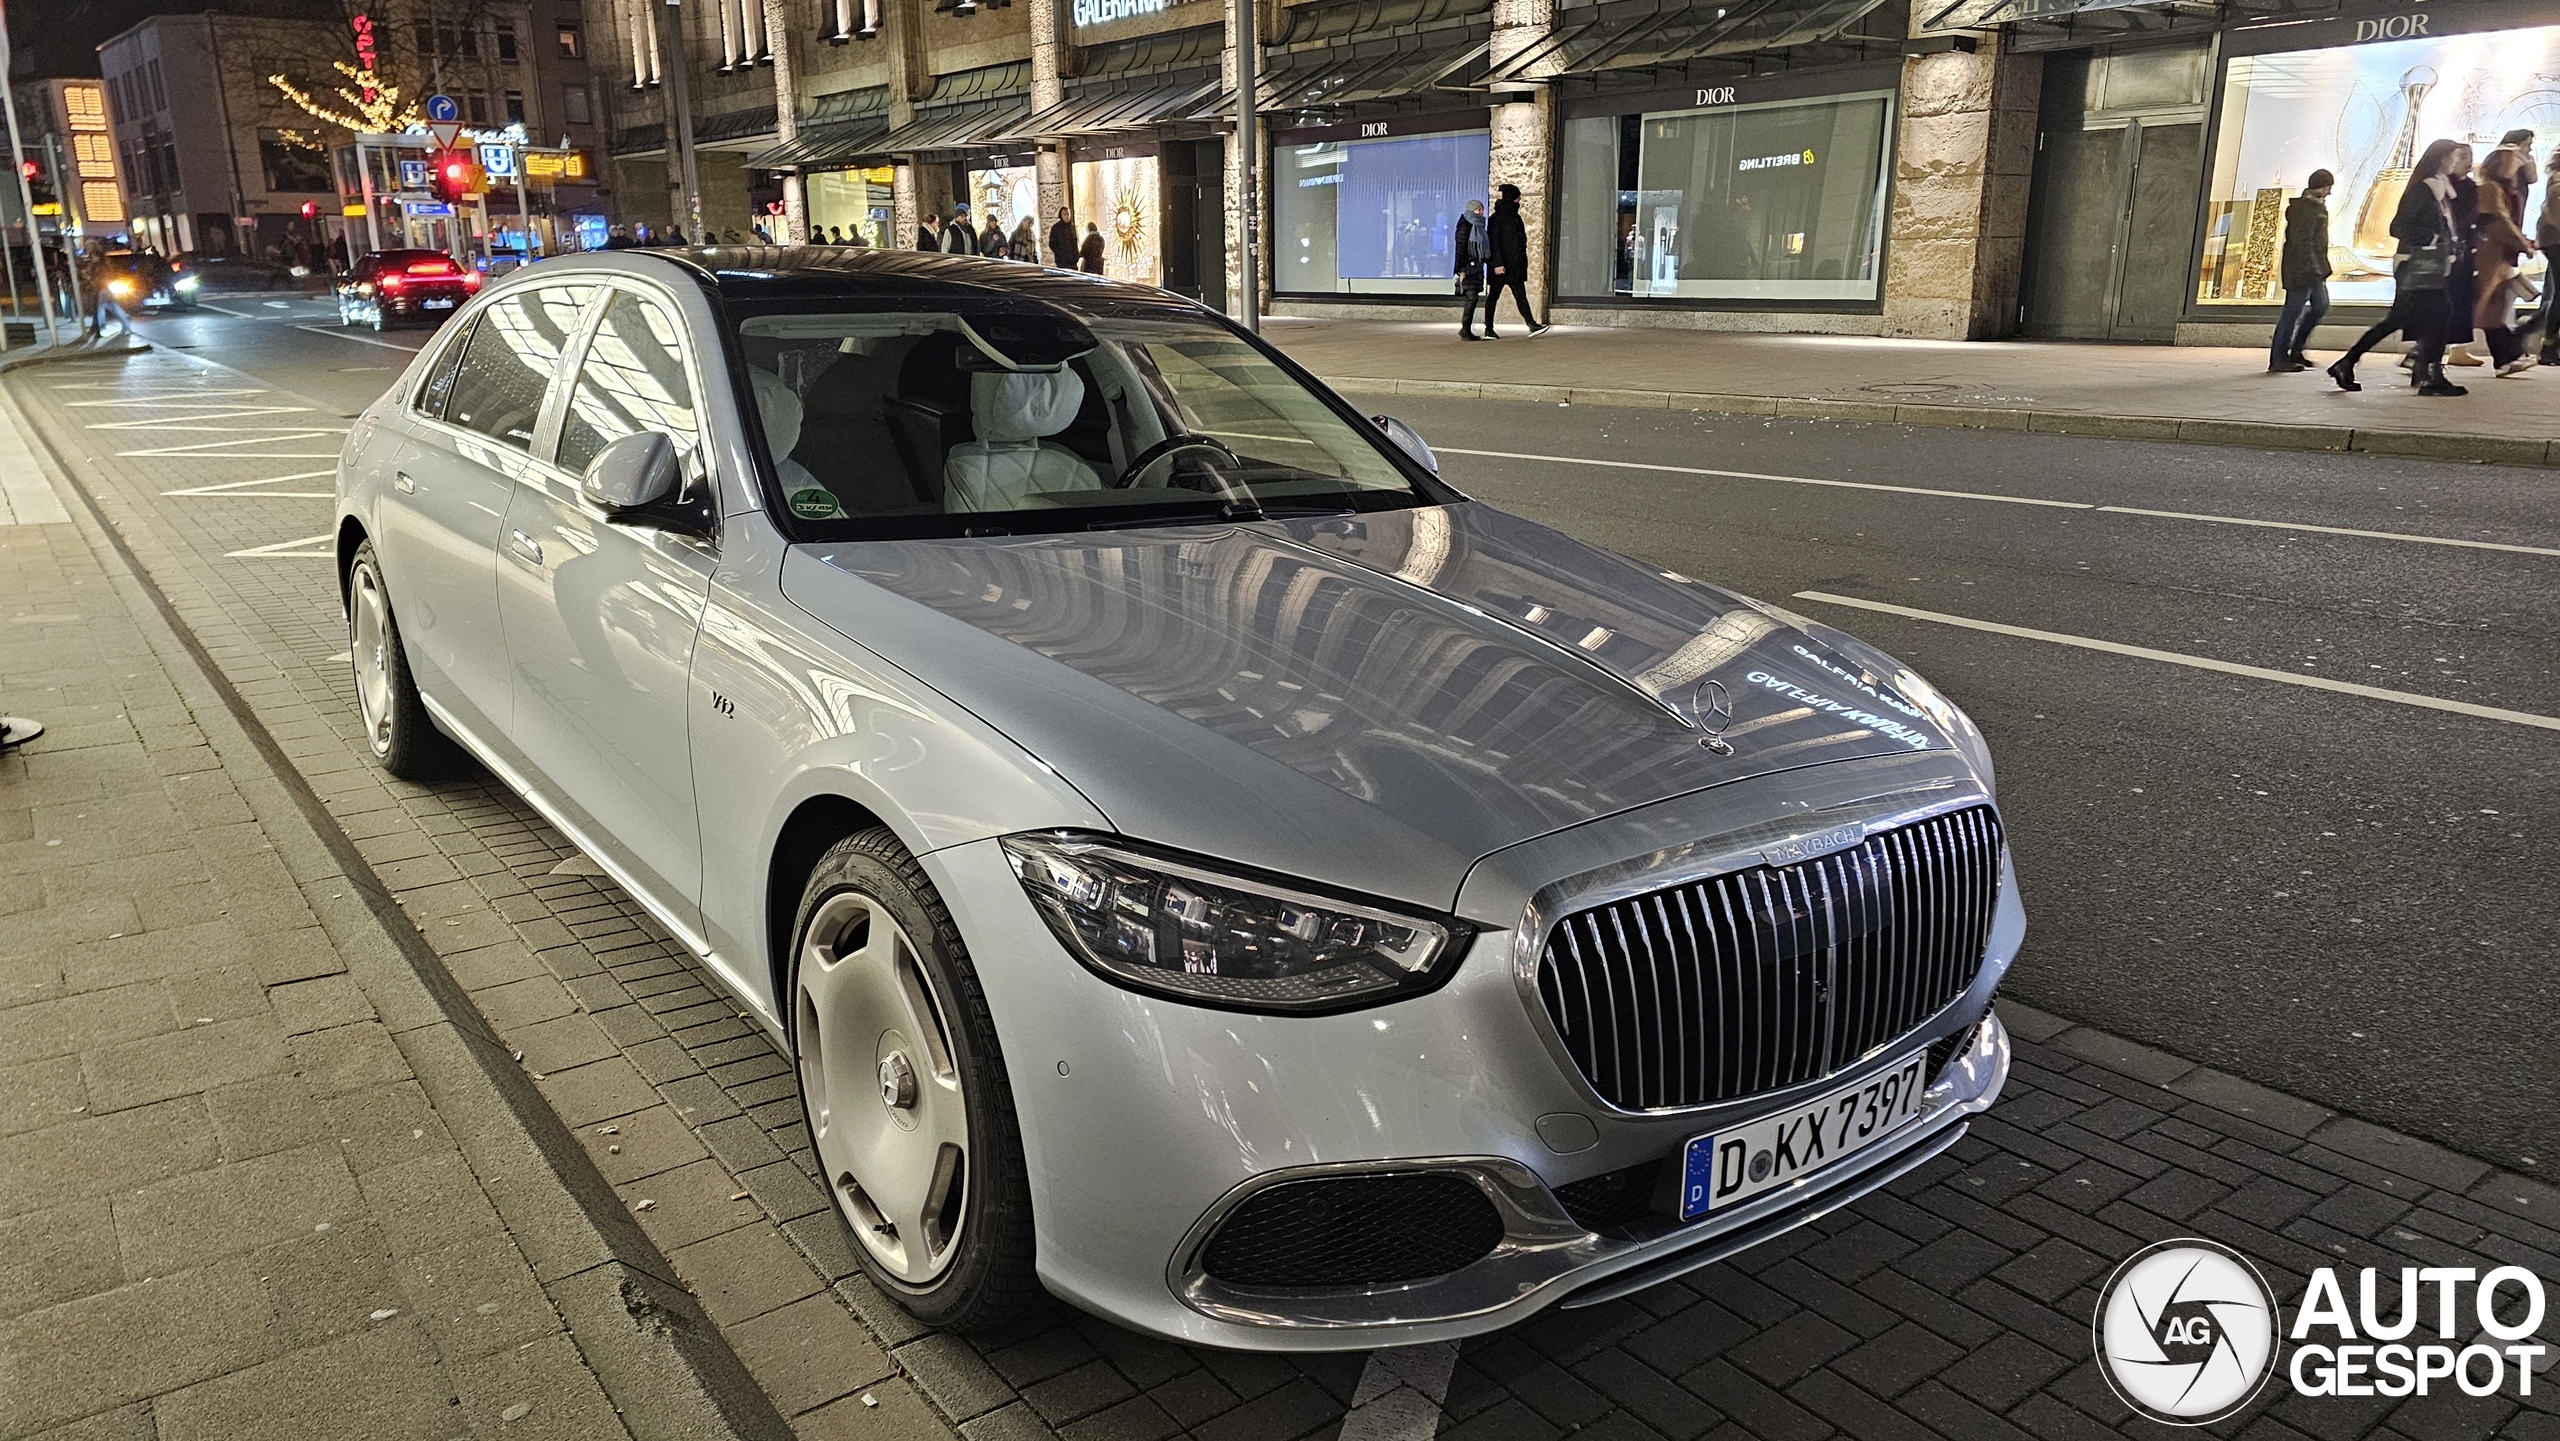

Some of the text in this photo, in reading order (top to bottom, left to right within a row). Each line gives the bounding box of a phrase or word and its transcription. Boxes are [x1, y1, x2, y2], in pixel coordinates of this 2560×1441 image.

[2354, 14, 2429, 42] DIOR
[1696, 86, 1736, 106] DIOR
[1361, 122, 1388, 137] DIOR
[1105, 147, 1124, 159] DIOR
[993, 158, 1010, 168] DIOR
[806, 489, 821, 504] 4
[712, 691, 735, 719] V12
[1776, 827, 1855, 861] MAYBACH
[1716, 1060, 1921, 1199] D KX 7397
[1691, 1185, 1703, 1203] D
